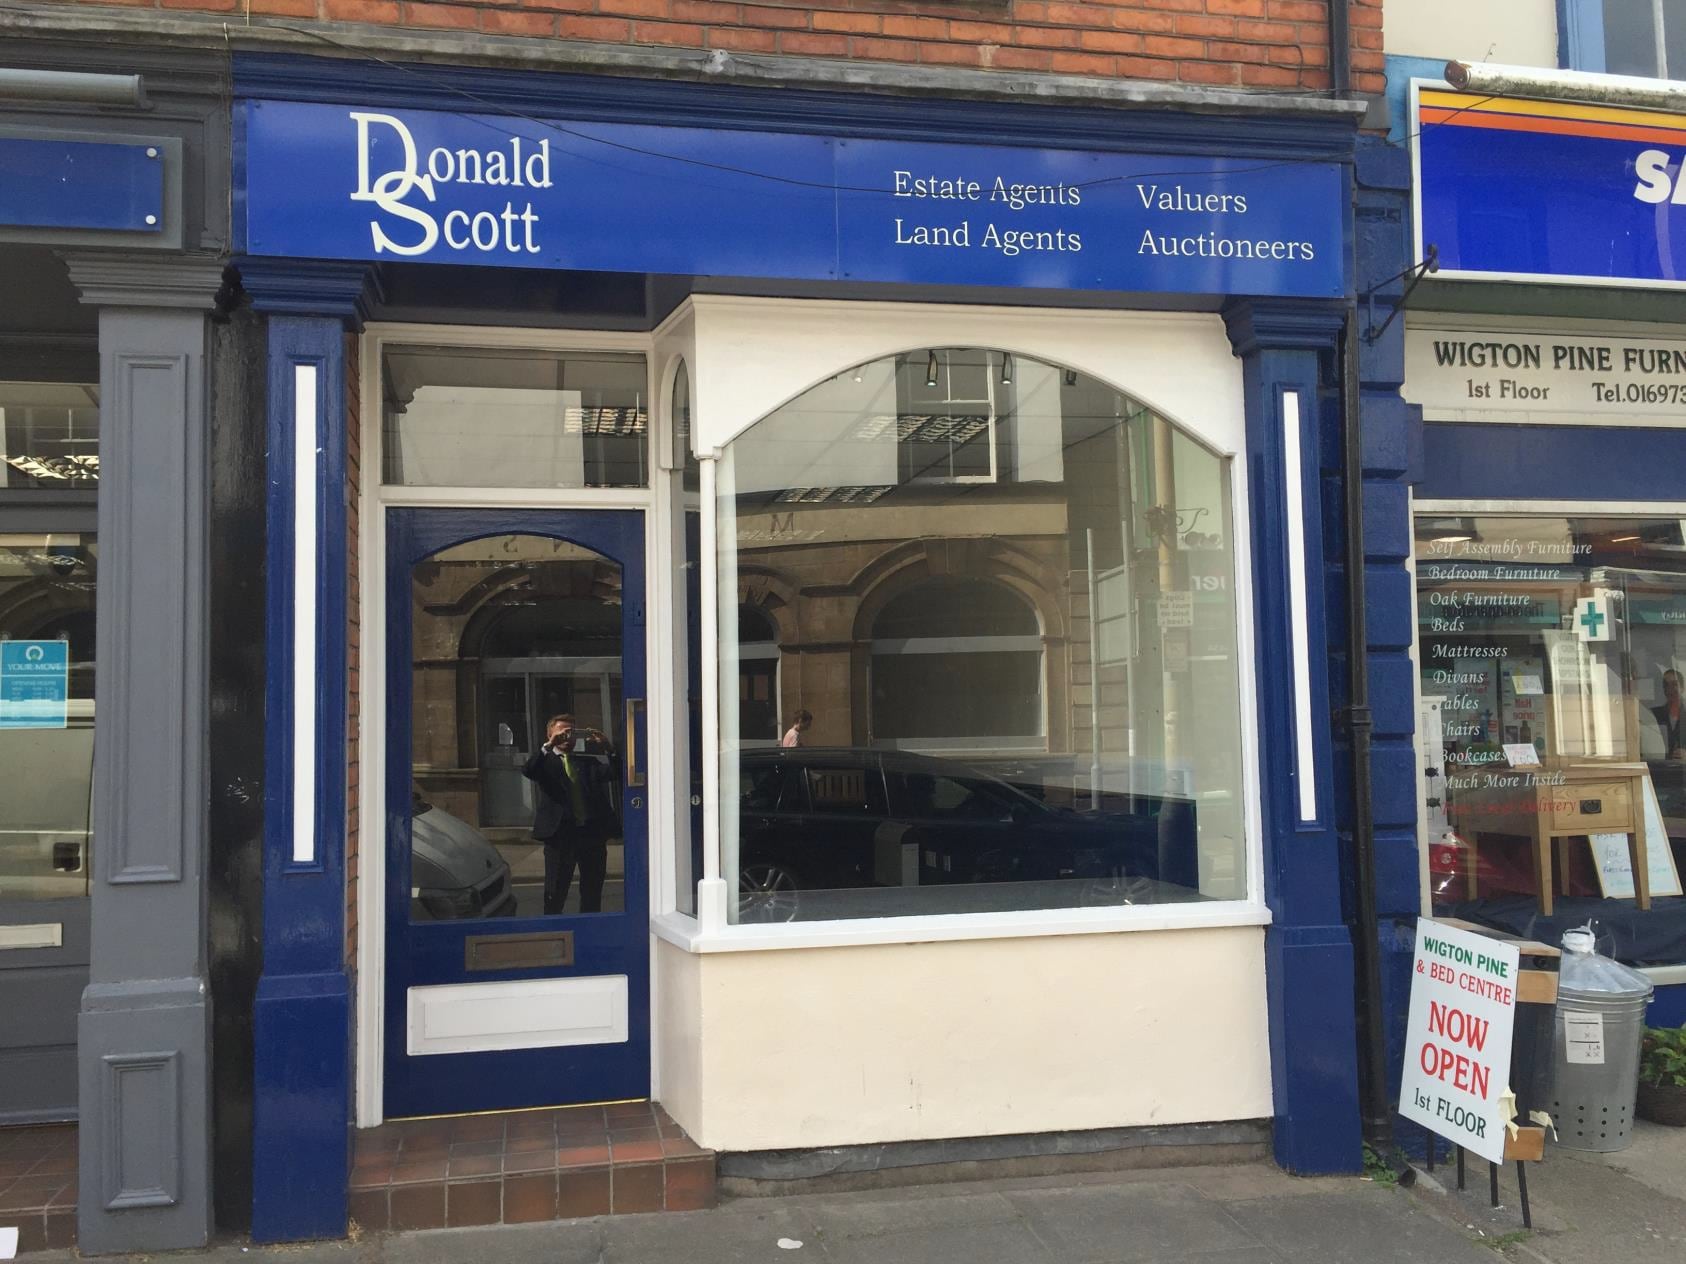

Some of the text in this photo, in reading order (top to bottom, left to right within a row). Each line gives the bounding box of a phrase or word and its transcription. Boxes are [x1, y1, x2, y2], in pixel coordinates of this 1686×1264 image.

[350, 112, 553, 201] Donald
[893, 171, 1081, 210] Estate Agents
[1136, 184, 1247, 213] Valuers
[371, 171, 541, 255] Scott
[894, 219, 1082, 256] Land Agents
[1138, 229, 1314, 260] Auctioneers
[1433, 341, 1686, 374] WIGTON PINE FURN
[1467, 379, 1491, 398] 1st
[1499, 379, 1550, 399] Floor
[1427, 539, 1592, 558] Self Assembly Furniture
[1428, 564, 1560, 579] Bedroom Furniture
[1430, 591, 1530, 608] Oak Furniture
[1432, 616, 1465, 631] Beds
[1432, 644, 1508, 658] Mattresses
[1433, 670, 1484, 684] Divans
[1442, 747, 1507, 764] Bookcases
[1483, 774, 1519, 788] More
[1525, 770, 1566, 787] Inside
[1424, 936, 1509, 978] WIGTON PINE
[1417, 959, 1512, 1006] & BED CENTRE
[1428, 1000, 1490, 1053] NOW
[1420, 1042, 1491, 1101] OPEN
[1414, 1087, 1487, 1139] 1st FLOOR
